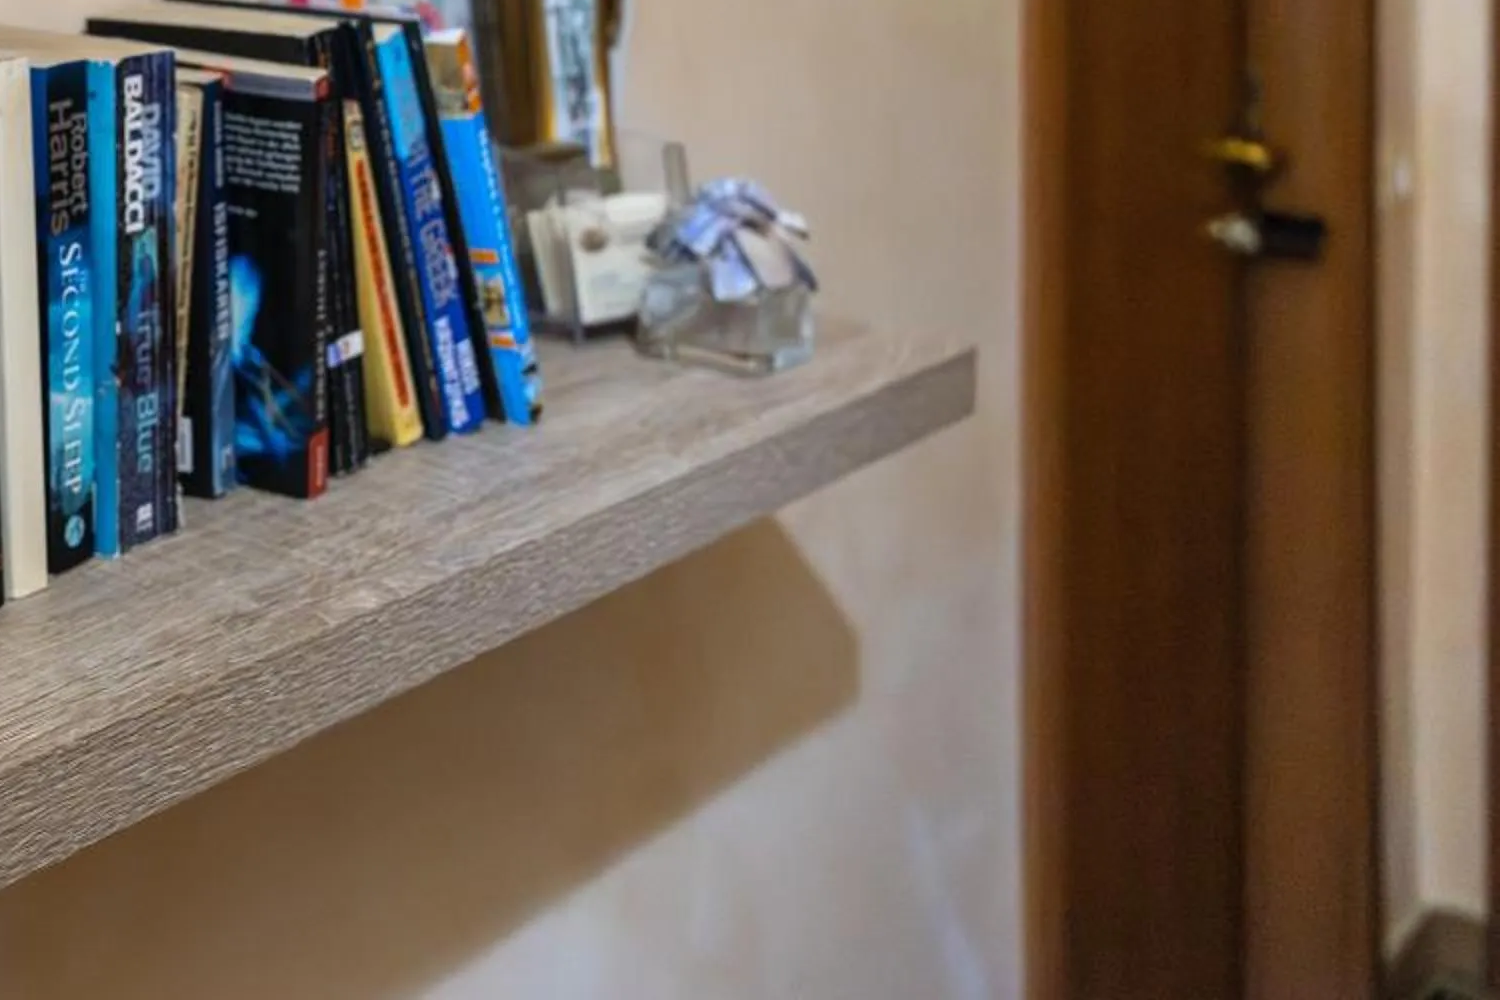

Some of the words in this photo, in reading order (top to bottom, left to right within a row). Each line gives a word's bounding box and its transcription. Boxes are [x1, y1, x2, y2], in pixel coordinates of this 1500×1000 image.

[49, 99, 70, 236] Harris
[70, 110, 88, 215] Robert
[124, 73, 145, 235] BALDACCI
[143, 102, 162, 199] DAVID
[59, 241, 83, 391] SECOND
[62, 396, 84, 494] SLEEP
[137, 391, 160, 474] Blue
